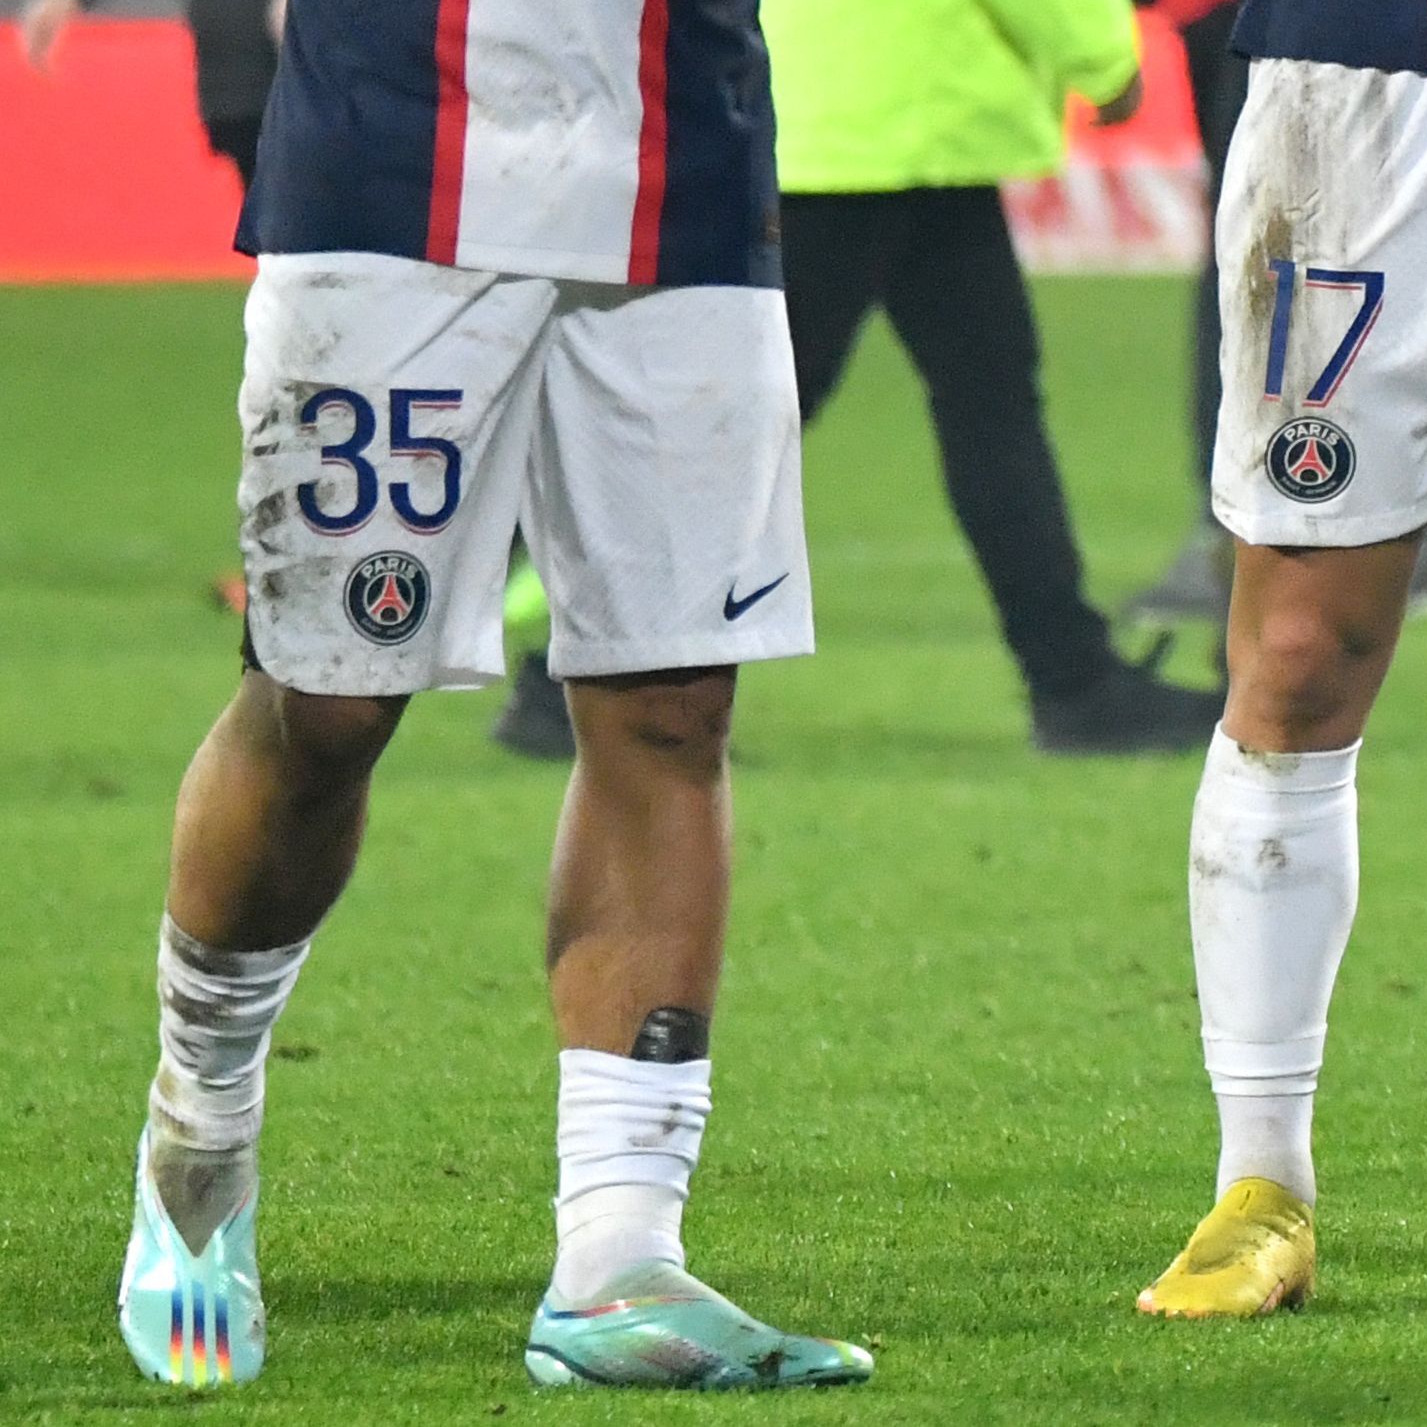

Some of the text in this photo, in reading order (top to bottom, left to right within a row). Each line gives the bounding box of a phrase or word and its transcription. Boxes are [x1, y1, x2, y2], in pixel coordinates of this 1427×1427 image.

[1263, 258, 1385, 408] 17
[297, 387, 464, 538] 35
[1283, 423, 1341, 446] PARIS
[361, 557, 418, 580] PARIS
